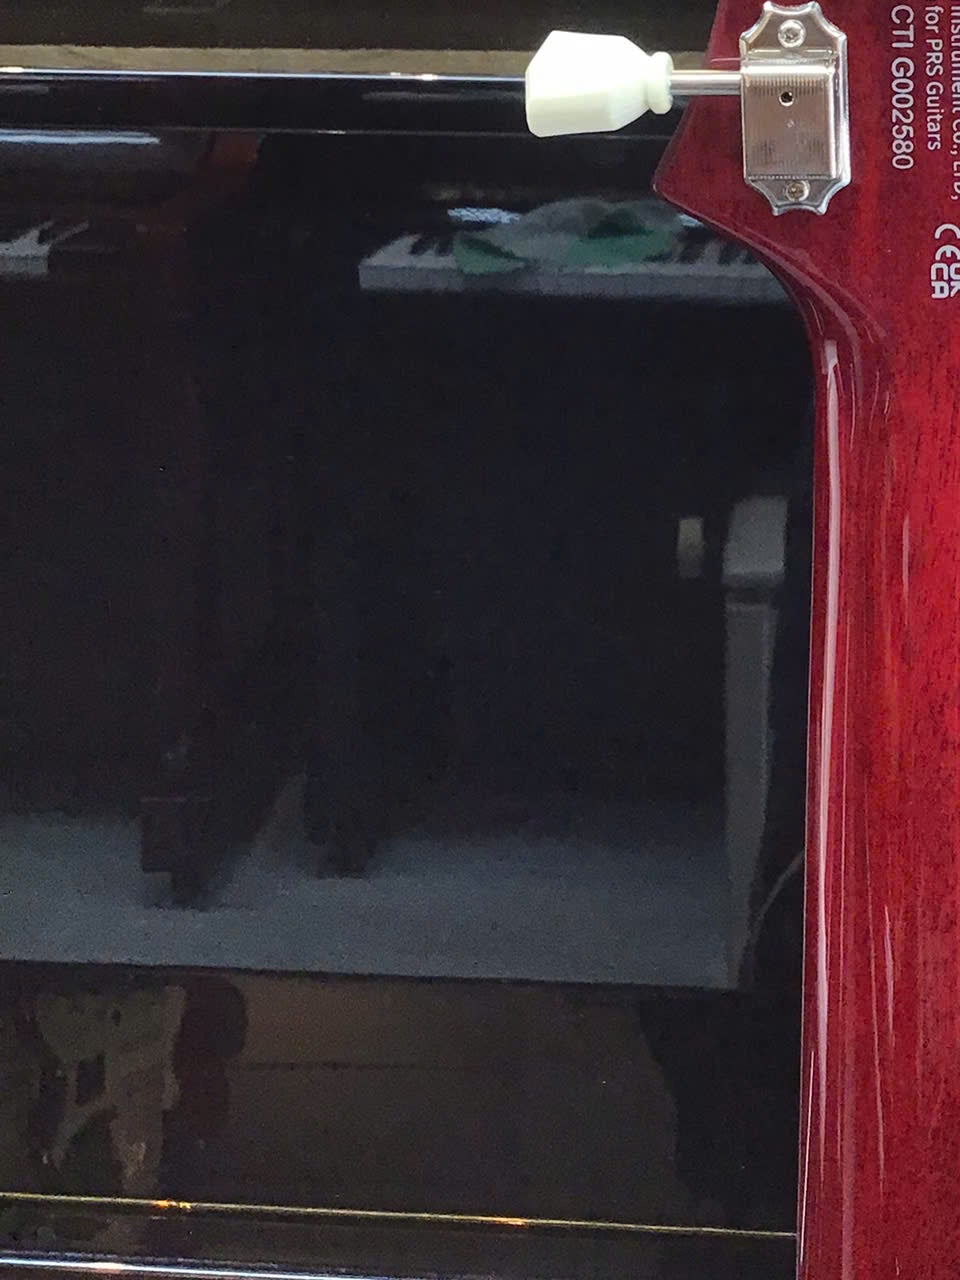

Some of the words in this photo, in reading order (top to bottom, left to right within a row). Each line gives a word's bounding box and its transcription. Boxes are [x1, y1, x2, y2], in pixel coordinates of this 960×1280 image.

[891, 4, 915, 49] CTI
[924, 5, 944, 34] for
[925, 39, 944, 77] PRS
[891, 56, 915, 170] G002580
[926, 81, 945, 151] Guitars
